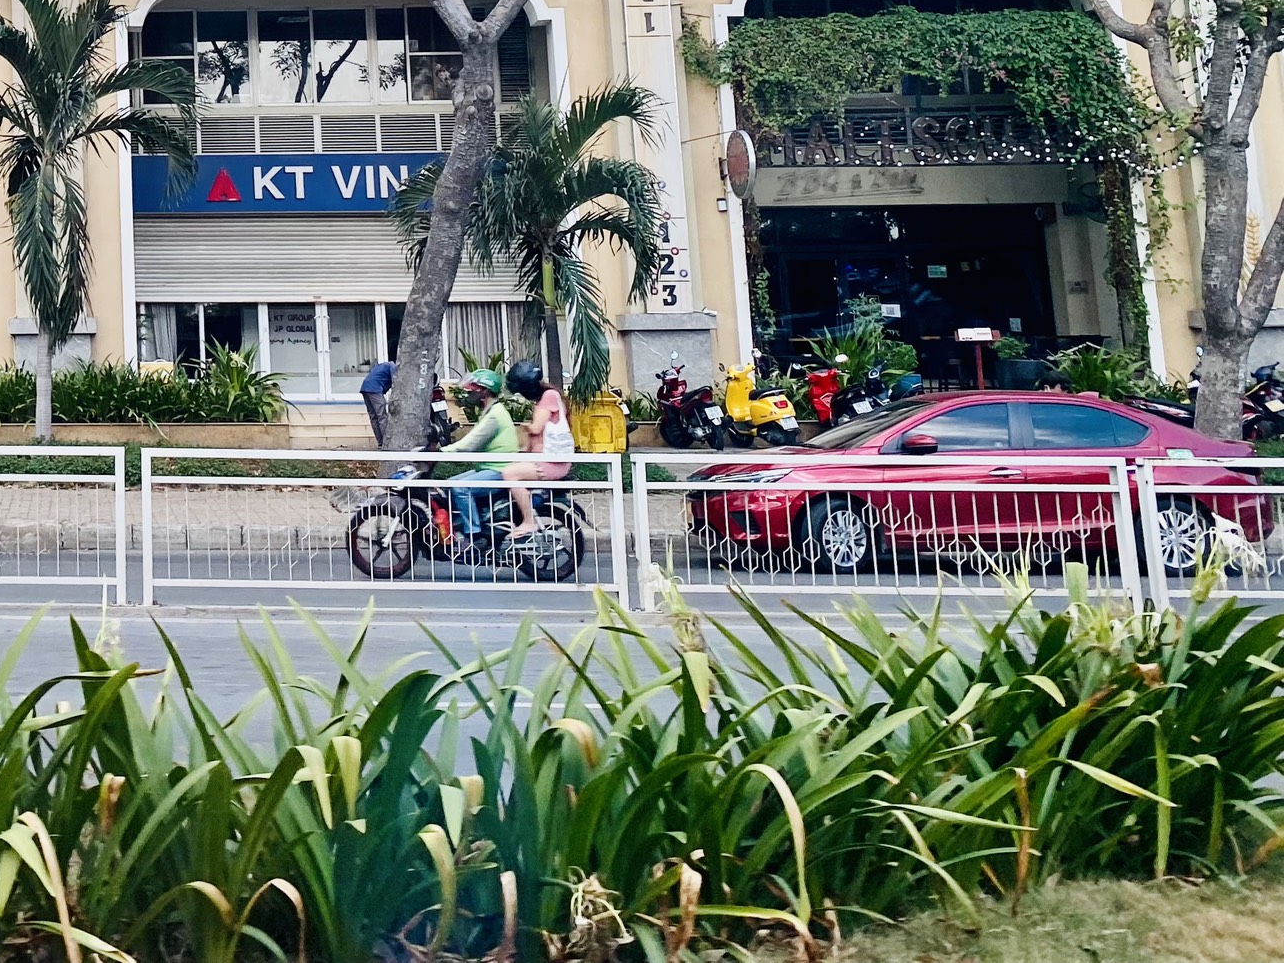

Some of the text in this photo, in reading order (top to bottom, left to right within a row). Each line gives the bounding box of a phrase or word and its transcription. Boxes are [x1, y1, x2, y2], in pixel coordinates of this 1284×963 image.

[253, 166, 314, 200] KT
[660, 254, 676, 275] 2
[662, 285, 677, 306] 3
